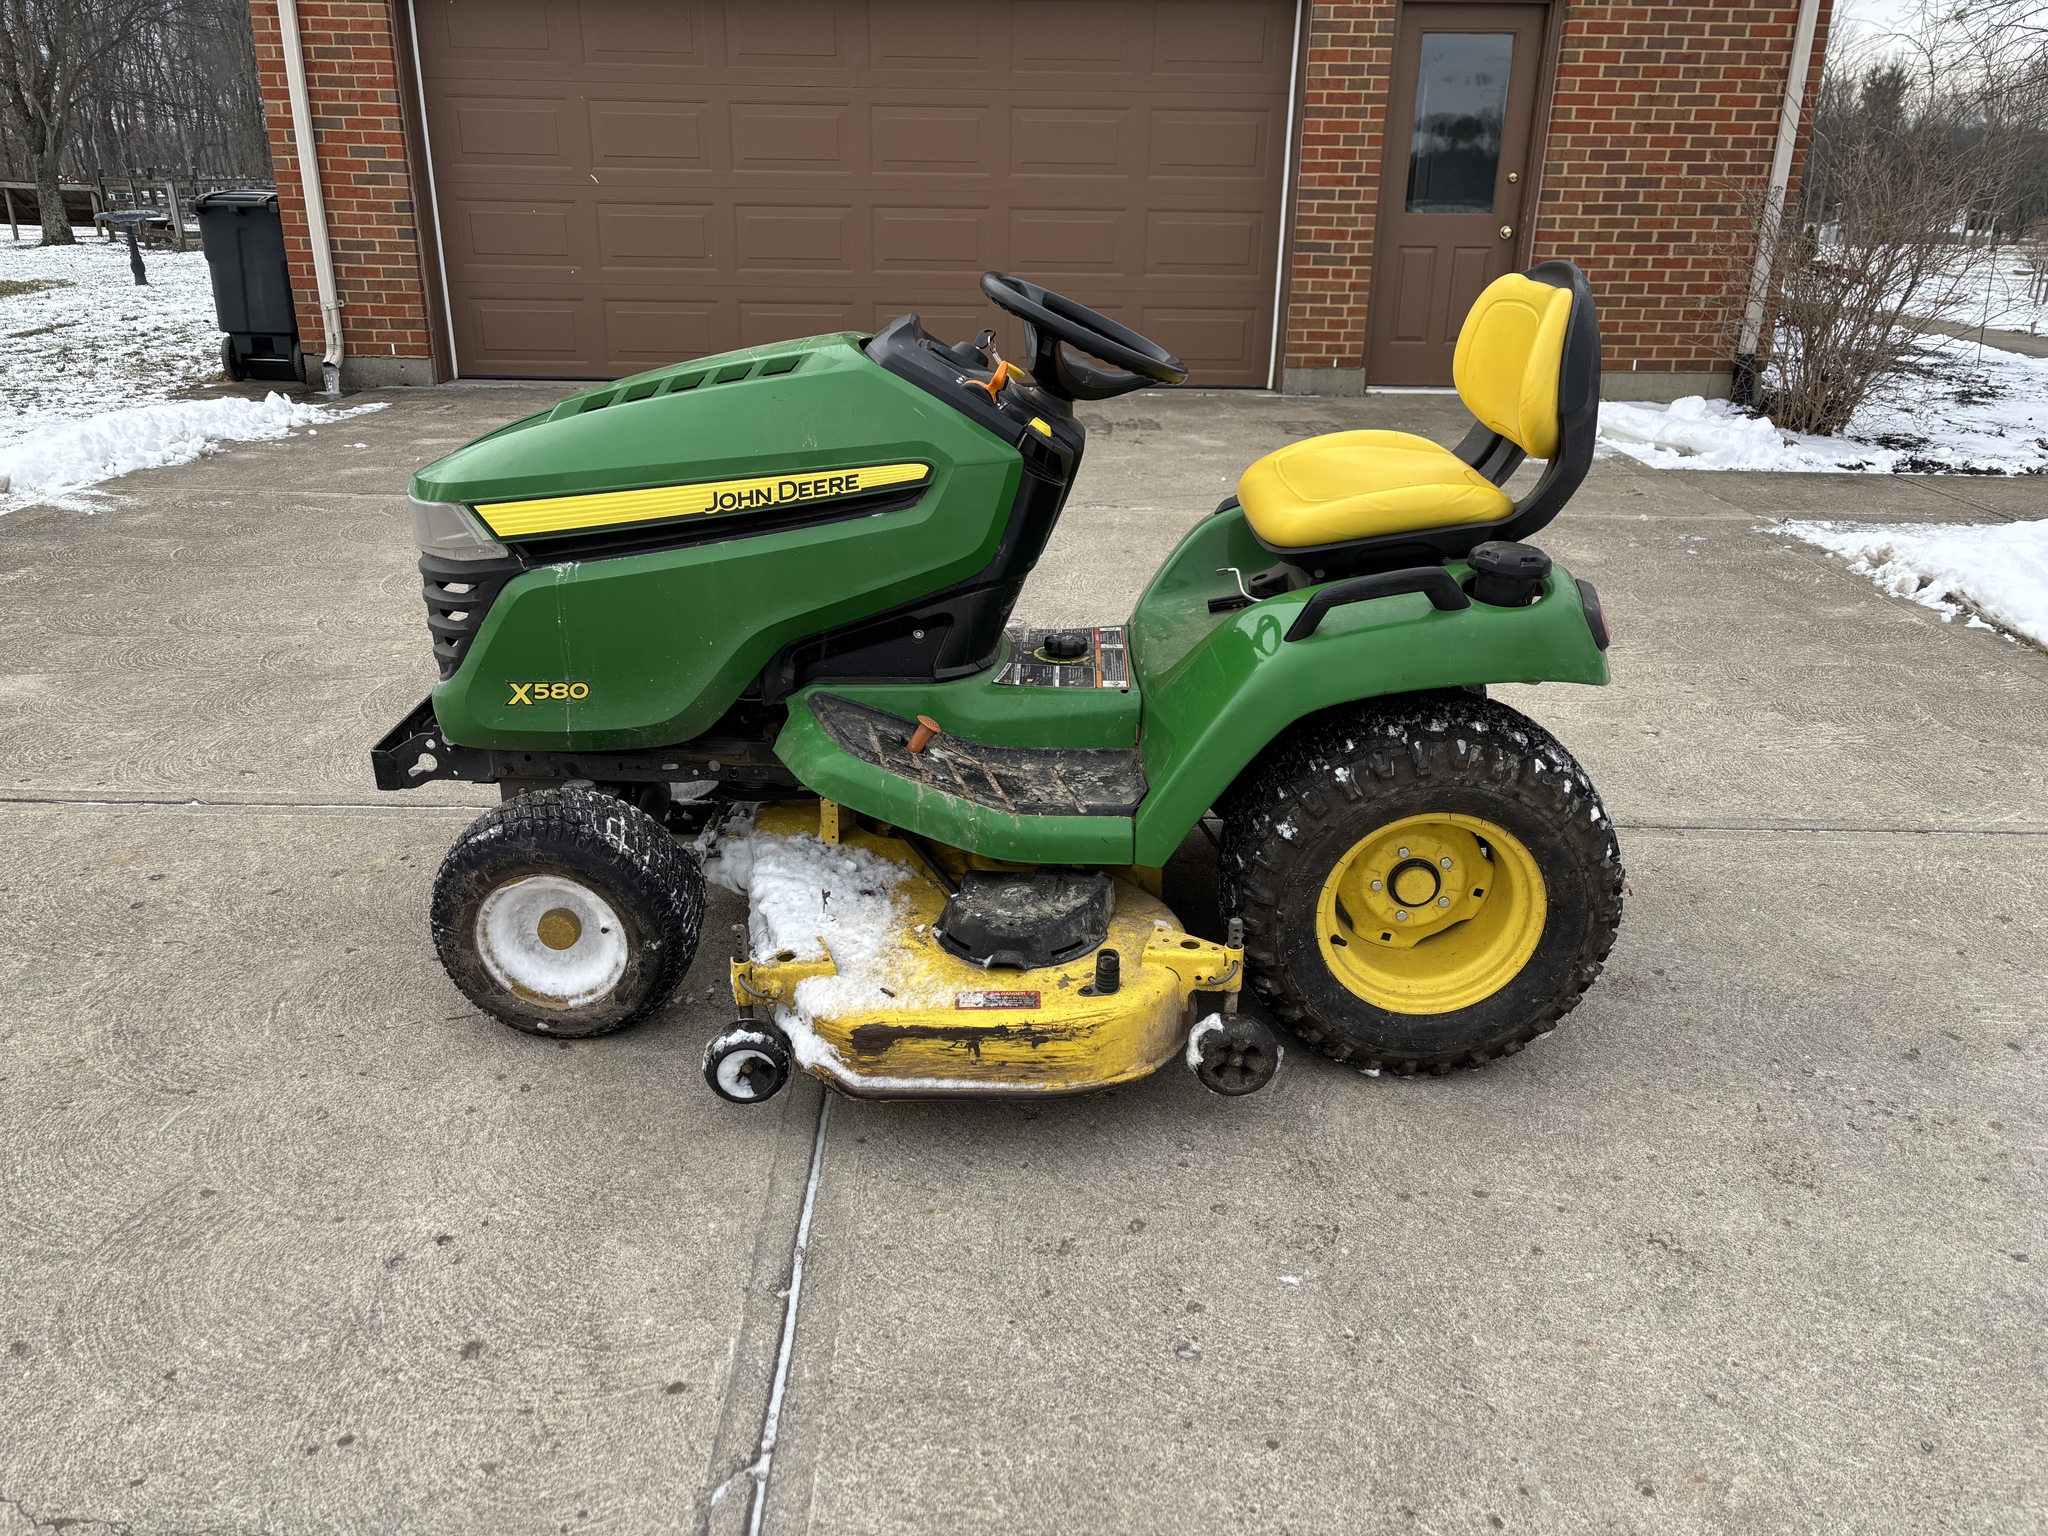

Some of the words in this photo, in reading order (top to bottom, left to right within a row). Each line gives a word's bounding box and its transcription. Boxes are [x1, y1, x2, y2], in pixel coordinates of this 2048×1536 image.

[704, 486, 772, 512] JOHN
[778, 473, 860, 501] DEERE
[505, 682, 590, 706] X580
